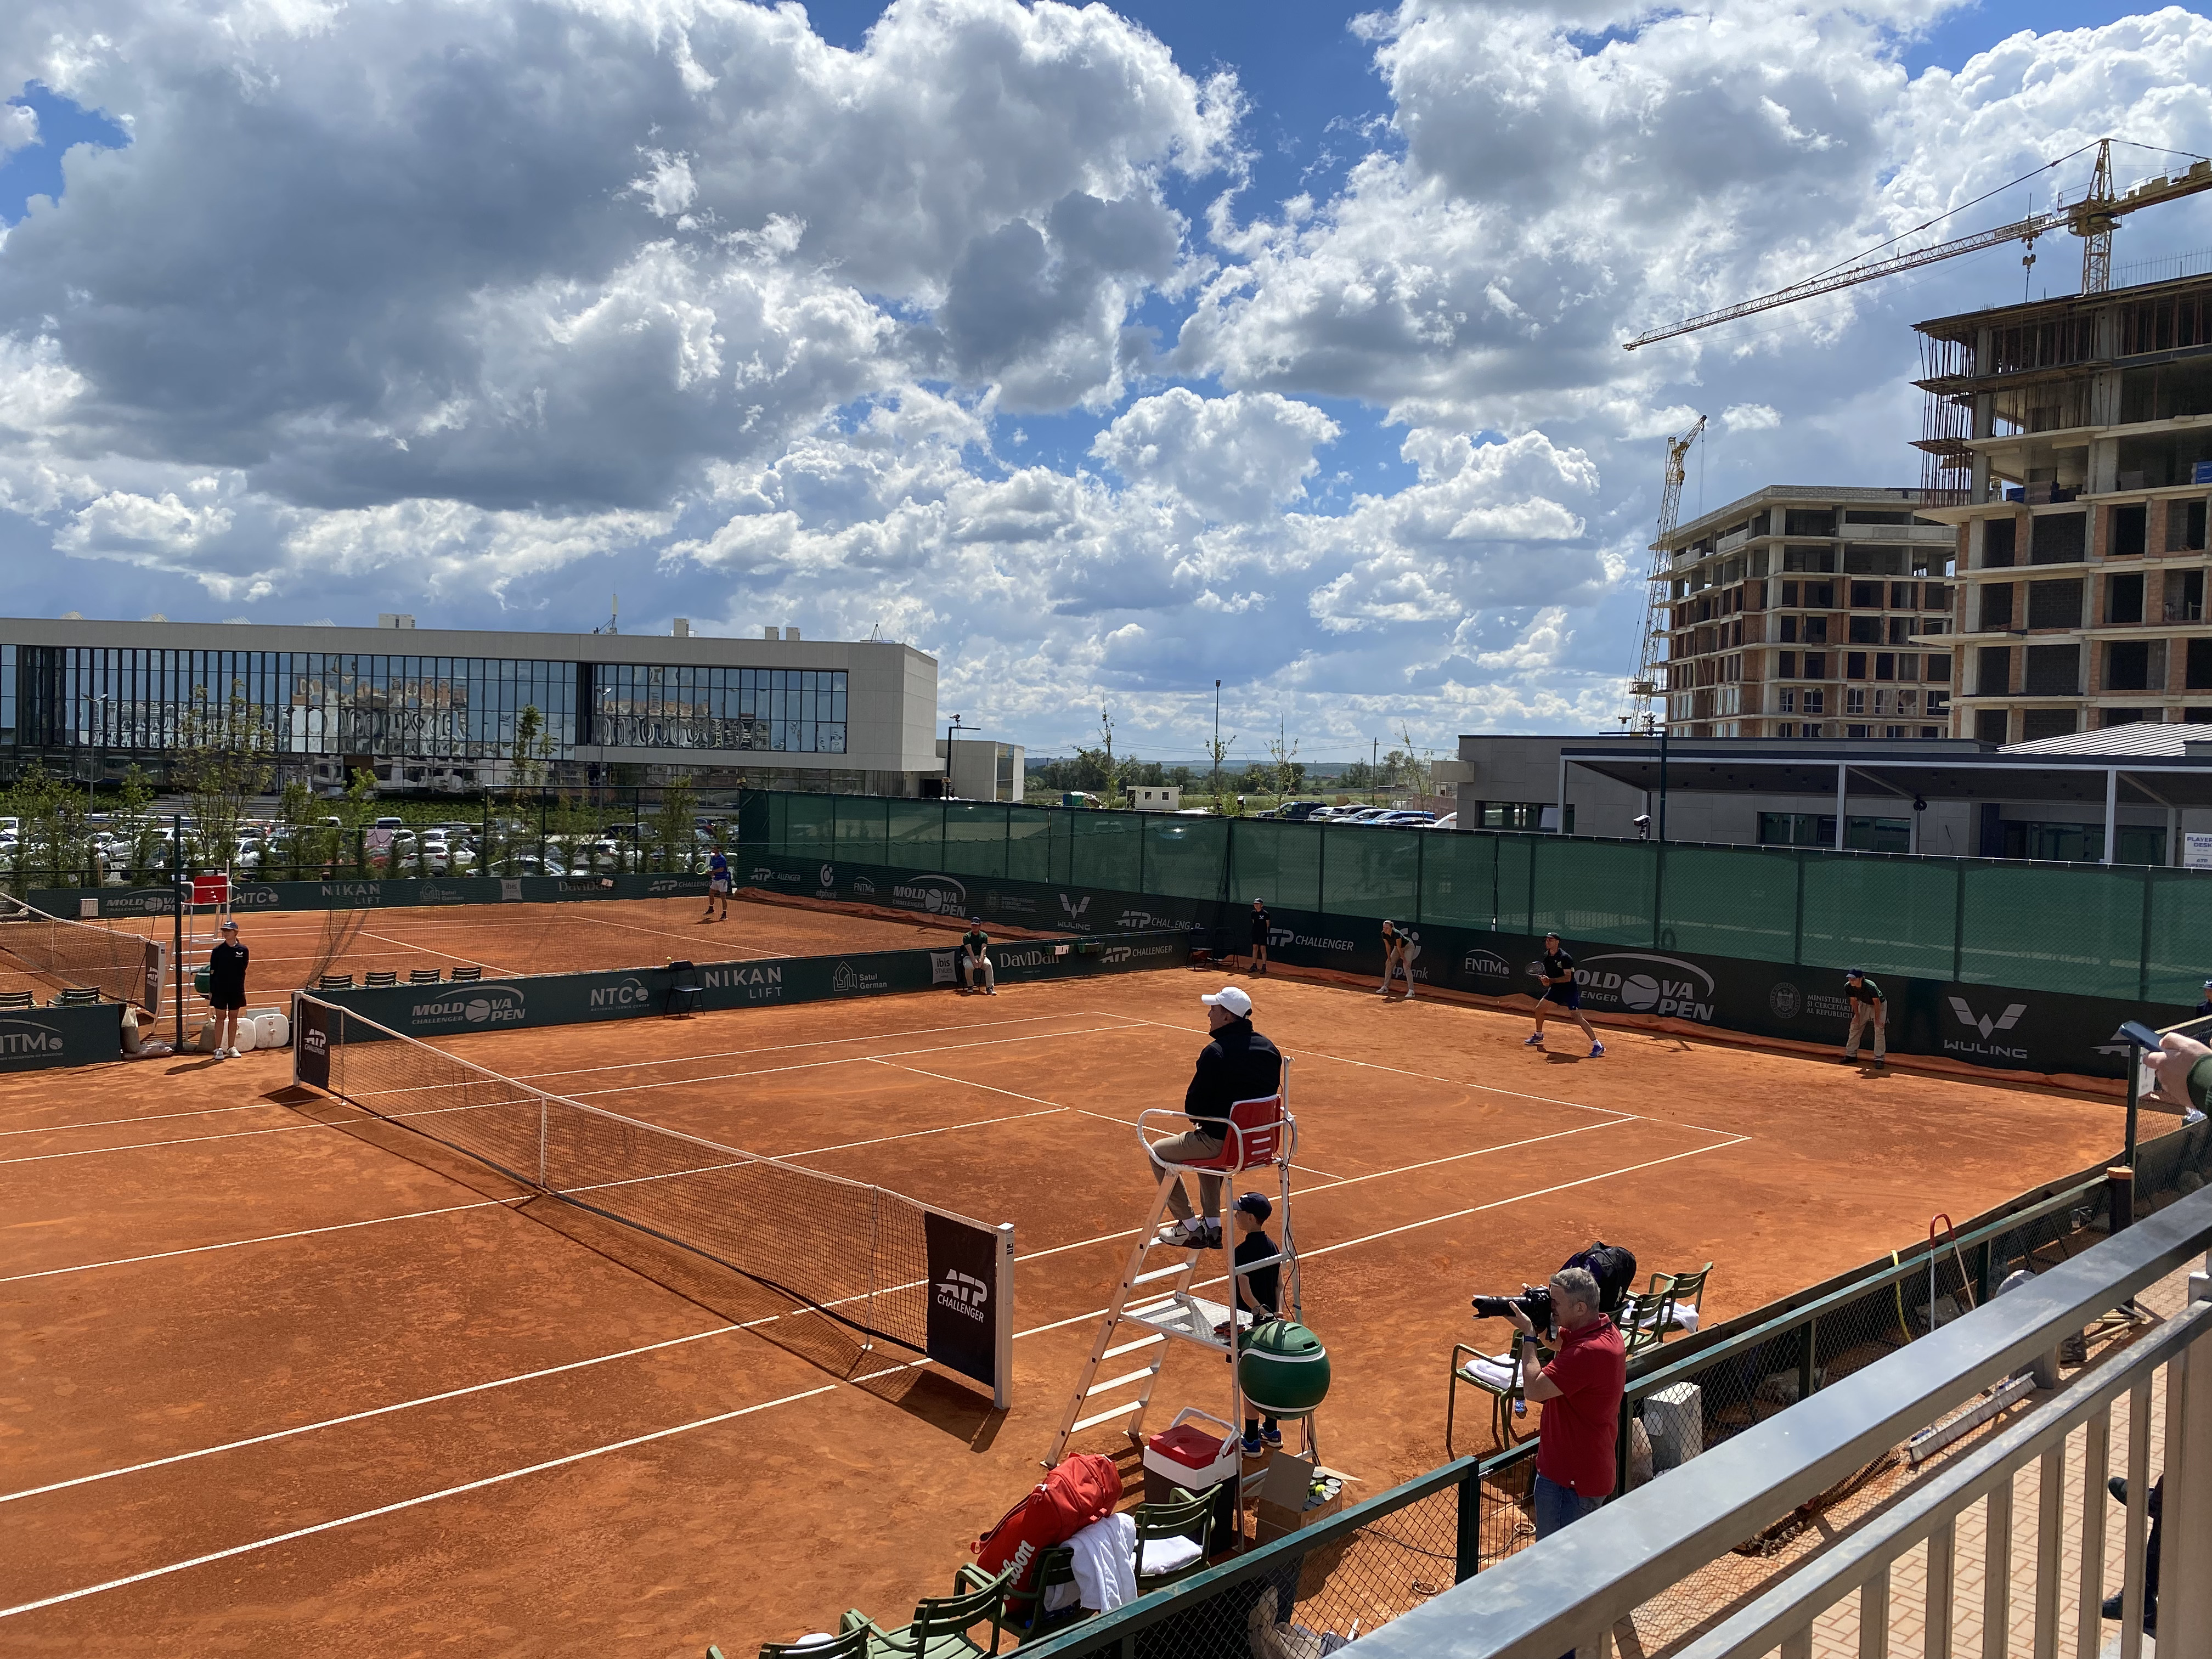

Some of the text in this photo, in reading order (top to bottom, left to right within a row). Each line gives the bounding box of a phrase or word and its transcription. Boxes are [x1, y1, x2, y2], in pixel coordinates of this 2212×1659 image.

[749, 867, 800, 882] ATP CALLENGER
[321, 883, 380, 896] NIKAN
[647, 880, 678, 891] ATP
[854, 883, 871, 893] FNTM
[236, 892, 267, 904] NTC
[1057, 921, 1091, 930] WULING
[1114, 911, 1151, 928] ATP
[1267, 928, 1354, 951] TP CHALLENGER
[1098, 945, 1172, 963] ATP CHALLENGER
[936, 958, 950, 967] ibis
[1465, 958, 1502, 974] FNTM
[705, 967, 782, 988] NIKAN
[590, 986, 633, 1006] NTC
[749, 987, 782, 999] LIFT
[1807, 994, 1848, 1004] MINISTERUL
[412, 1015, 464, 1025] CHALLENGER
[303, 1028, 326, 1048] ATP
[1944, 1040, 2028, 1059] WULING
[935, 1268, 988, 1307] ATP
[937, 1294, 984, 1323] CHALLENGER
